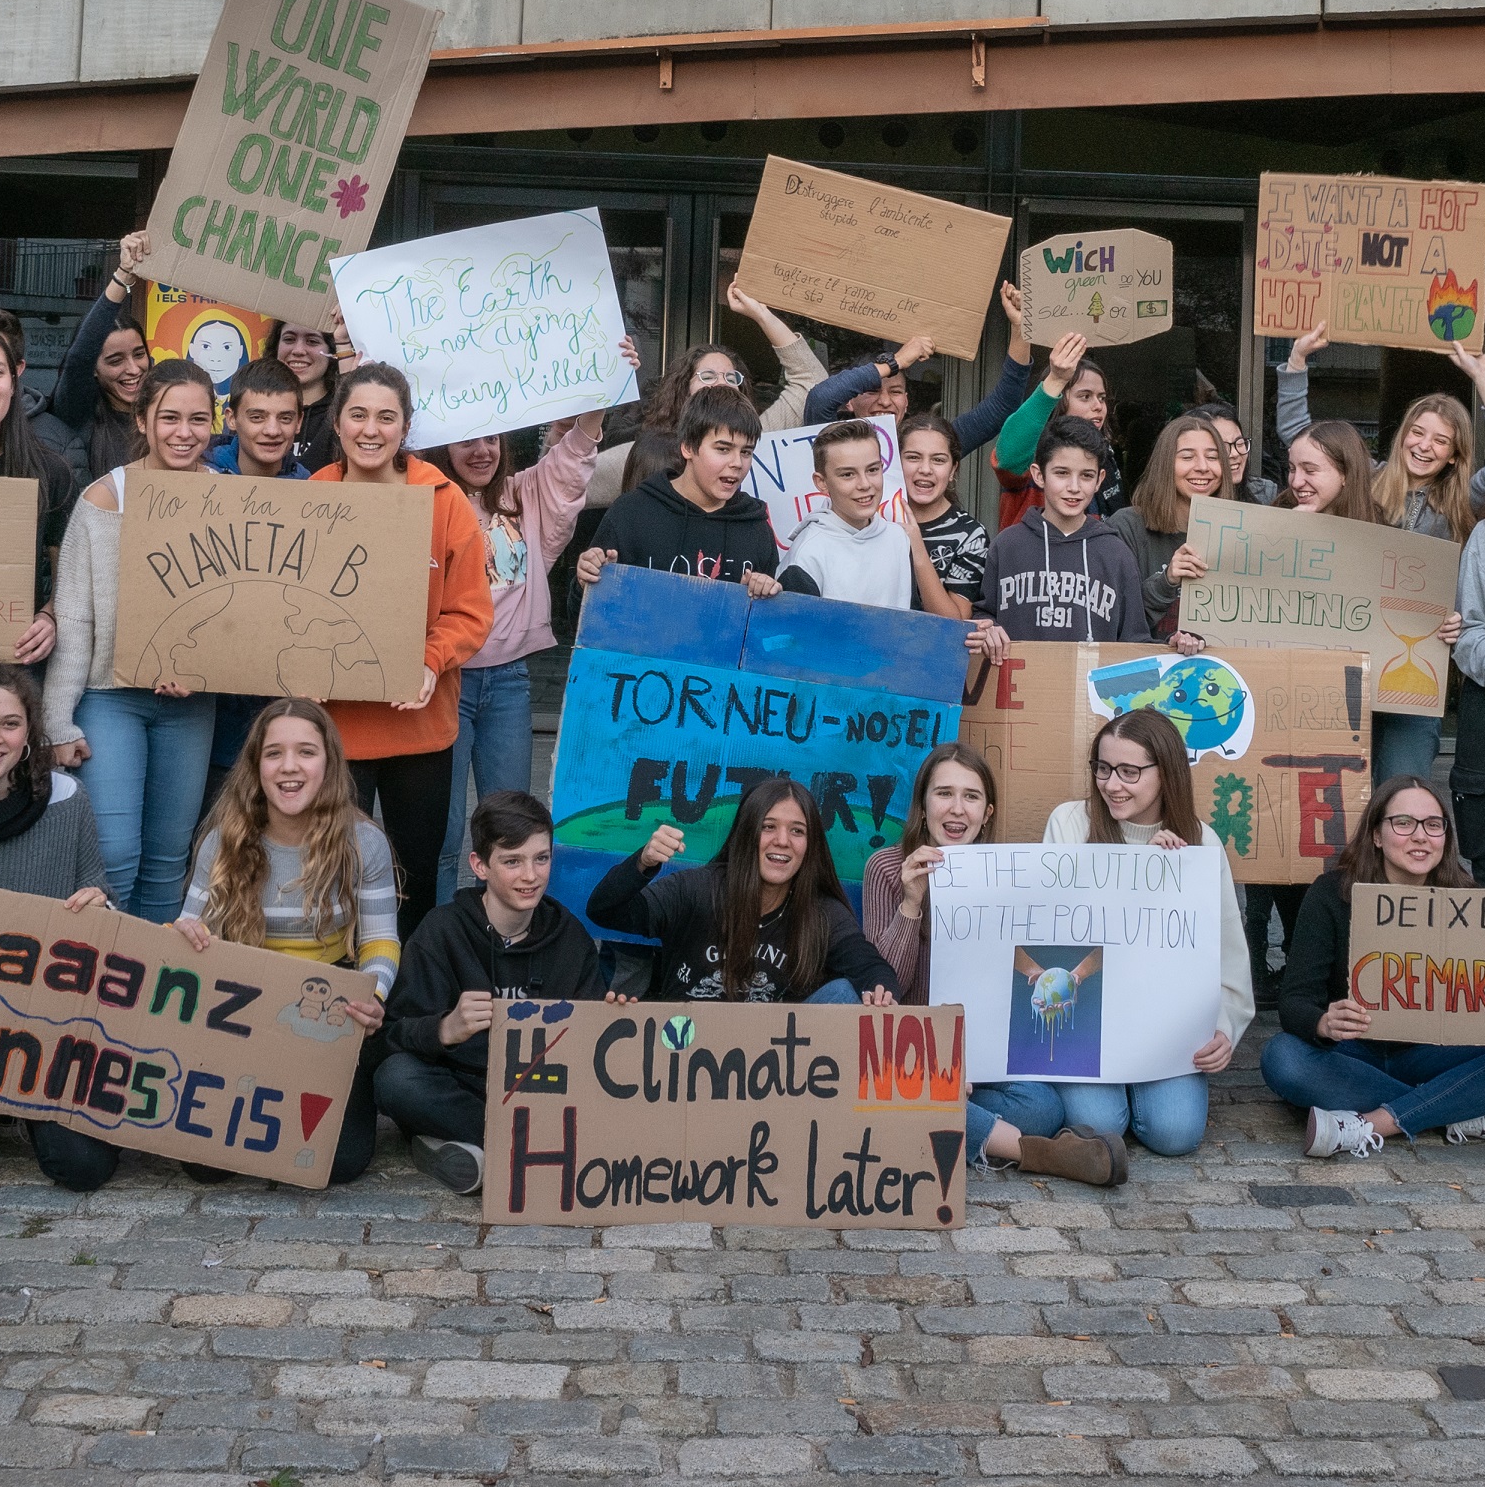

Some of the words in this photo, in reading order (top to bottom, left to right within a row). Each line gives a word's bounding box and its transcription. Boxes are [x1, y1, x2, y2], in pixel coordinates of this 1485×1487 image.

[221, 41, 382, 165] WORLD
[226, 133, 340, 214] ONE
[819, 206, 858, 228] stupido
[1268, 182, 1296, 223] I
[1304, 184, 1383, 226] WANT
[1388, 188, 1410, 228] A
[1419, 188, 1479, 231] HOT
[172, 195, 342, 294] CHANCE
[1361, 232, 1410, 268] NOT
[1421, 236, 1448, 275] A
[162, 294, 187, 303] ELS
[356, 275, 444, 334] The
[459, 260, 572, 319] Earth
[773, 261, 821, 288] tagliare
[825, 277, 840, 292] il
[844, 283, 877, 303] ramo
[897, 298, 921, 315] che
[781, 281, 795, 298] ci
[803, 287, 825, 305] sta
[1064, 274, 1108, 303] green
[1261, 278, 1322, 331] HOT
[1335, 281, 1426, 334] PLANET
[402, 341, 429, 364] is
[441, 323, 485, 355] not
[440, 376, 512, 414] being
[139, 483, 188, 522] No
[200, 483, 225, 519] hi
[240, 485, 282, 519] ha
[300, 500, 359, 535] cap
[146, 521, 307, 599] PLANETA
[330, 543, 368, 598] B
[999, 571, 1117, 622] PULL&BEAR
[1035, 605, 1073, 628] 1991
[624, 757, 899, 851] FUTR!
[931, 851, 968, 889] BE
[977, 850, 1031, 889] THE
[1040, 851, 1183, 894] SOLUTION
[934, 905, 990, 942] NOT
[995, 904, 1046, 942] THE
[1053, 904, 1197, 950] POLLUTION
[592, 1011, 841, 1104] Climate
[857, 1013, 965, 1103] NOW
[508, 1105, 780, 1215] Homework
